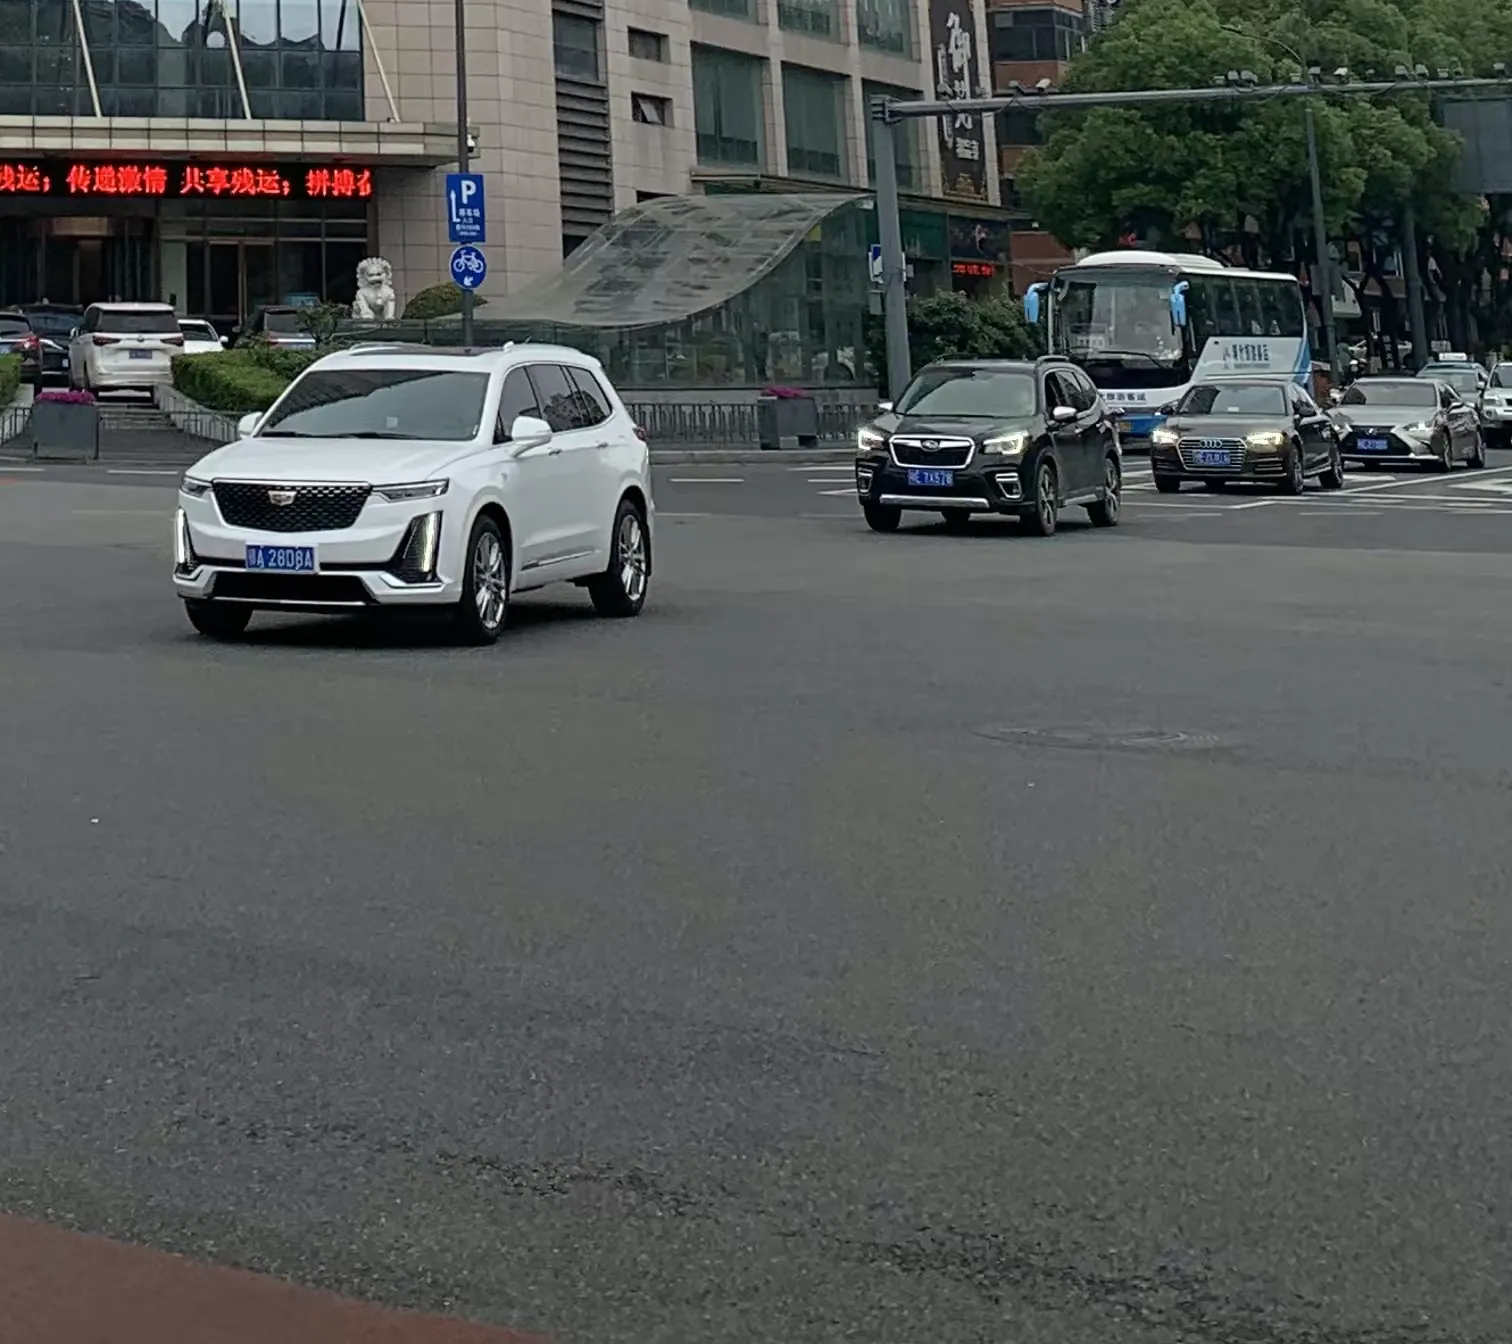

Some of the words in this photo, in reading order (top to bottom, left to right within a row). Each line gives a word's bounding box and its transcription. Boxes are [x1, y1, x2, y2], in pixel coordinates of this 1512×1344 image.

[66, 164, 167, 194] 传递激情
[461, 179, 477, 205] P
[1100, 392, 1146, 401] 旅游客运
